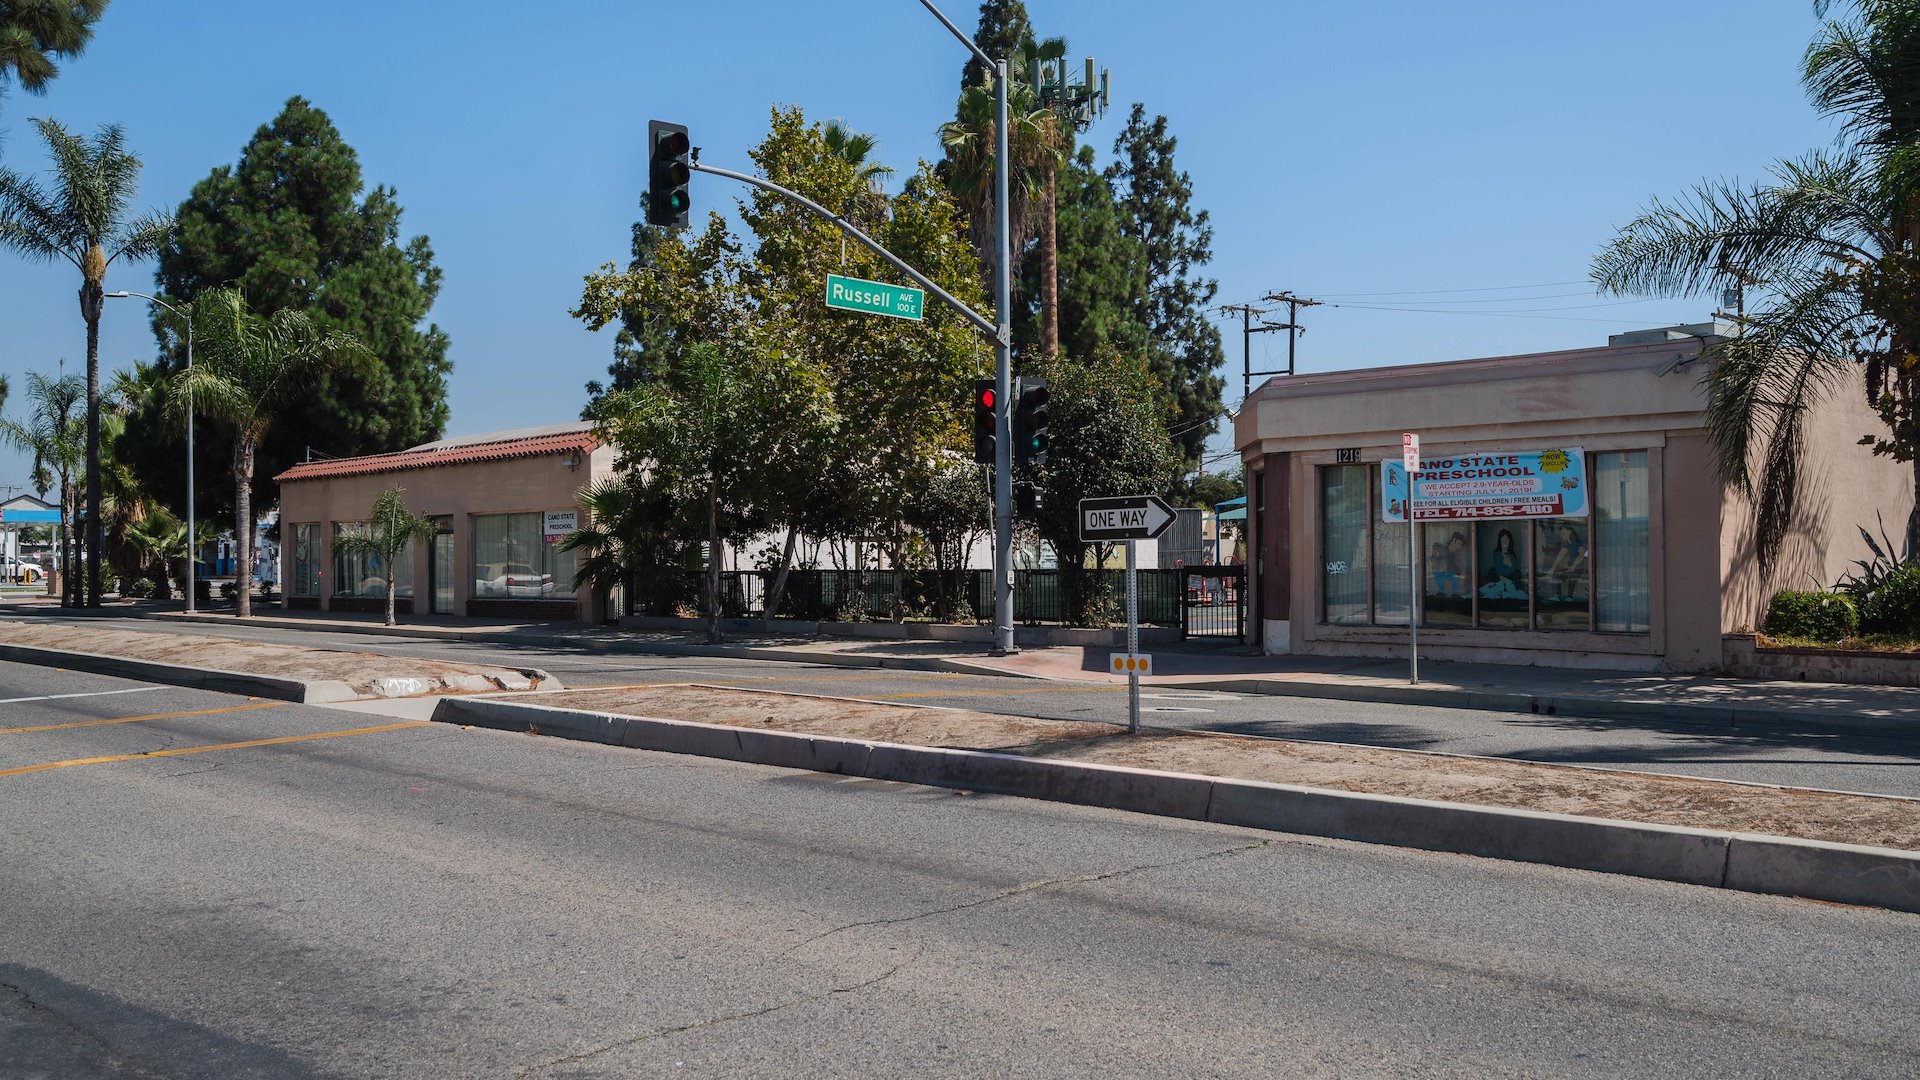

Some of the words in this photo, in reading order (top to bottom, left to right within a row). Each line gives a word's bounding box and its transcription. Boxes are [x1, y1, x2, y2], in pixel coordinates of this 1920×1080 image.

[833, 283, 890, 307] Russell
[899, 293, 914, 303] AVE
[897, 303, 909, 312] 100
[910, 305, 916, 314] E
[1337, 449, 1361, 462] 1219
[1419, 459, 1454, 470] ANO
[1460, 455, 1519, 467] STATE
[1413, 467, 1535, 480] PRESCHOOL
[1439, 482, 1471, 490] ACCEPT
[1473, 479, 1534, 488] 2.9-YEAR-OLDS
[1428, 489, 1472, 497] STARTING
[1479, 497, 1509, 505] CHILDREN
[1514, 496, 1530, 504] FREE
[1532, 495, 1556, 503] MEALS!
[1452, 504, 1553, 517] 714-835-4110
[1090, 511, 1116, 528] ONE
[1120, 509, 1147, 527] WAY
